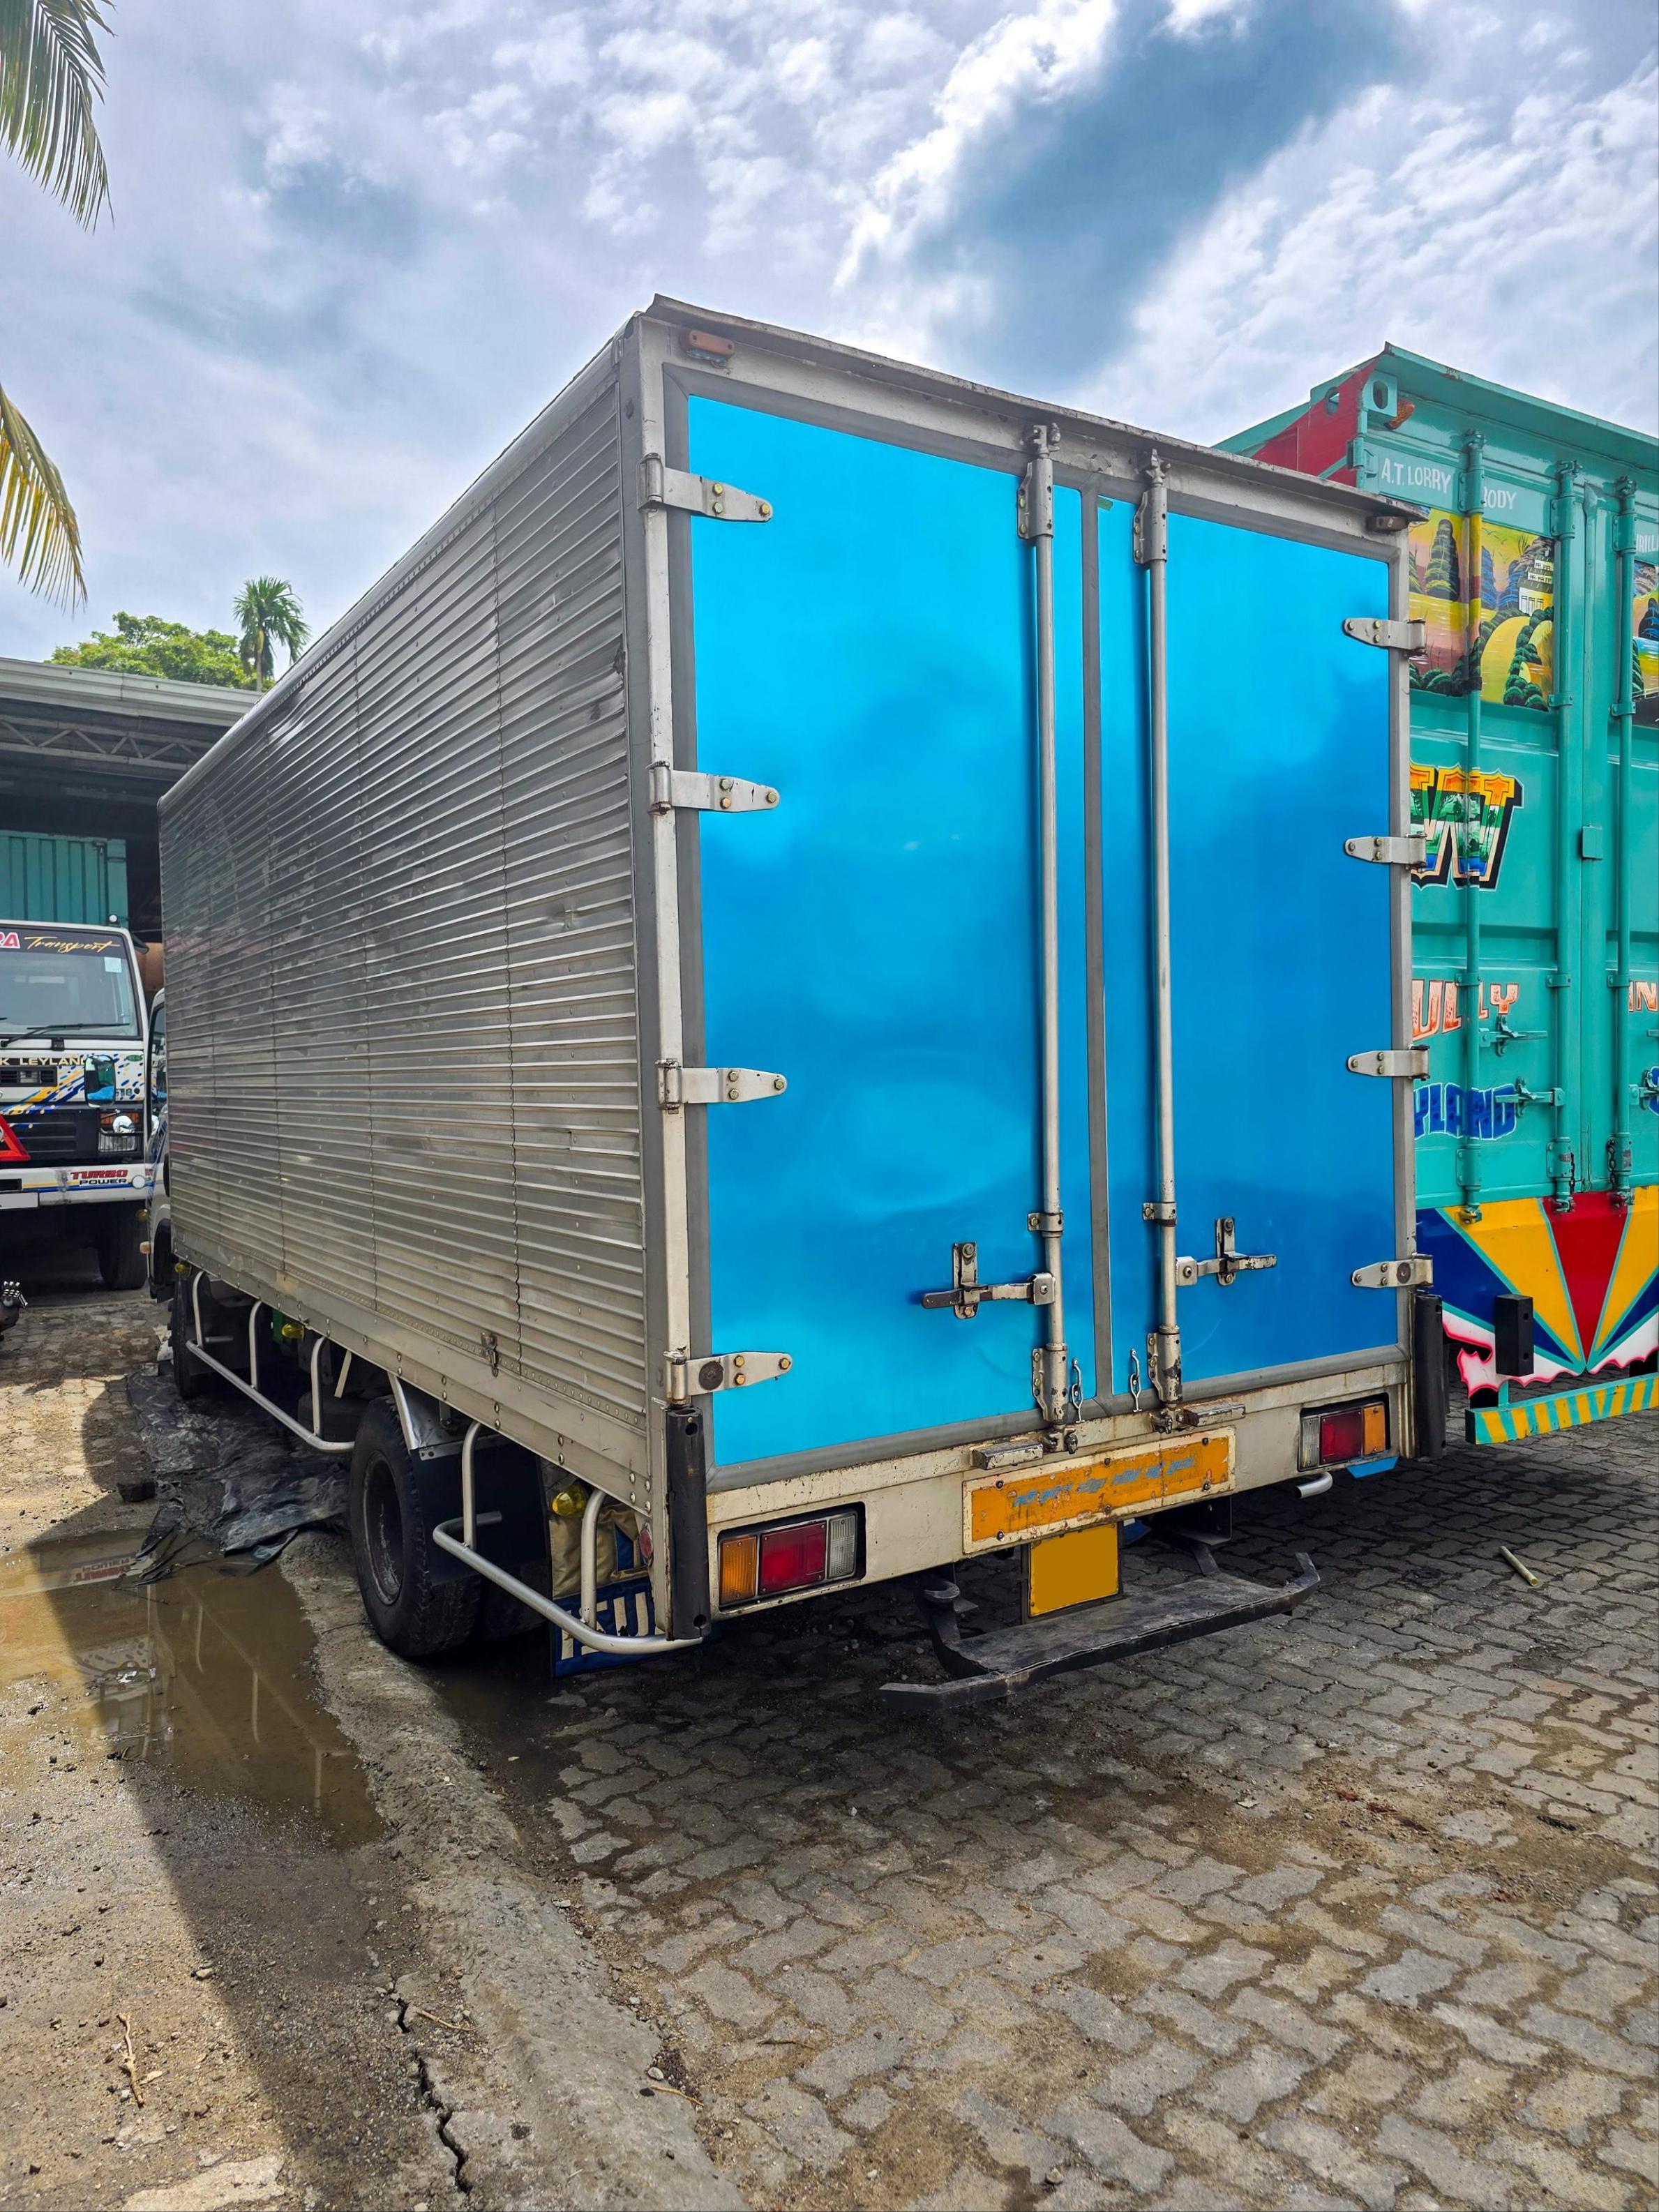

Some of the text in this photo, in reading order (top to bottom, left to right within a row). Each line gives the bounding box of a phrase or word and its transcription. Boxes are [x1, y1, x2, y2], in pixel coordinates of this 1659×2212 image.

[1408, 465, 1452, 494] LORRY
[0, 932, 120, 954] A Transport
[70, 1169, 128, 1180] TURBO
